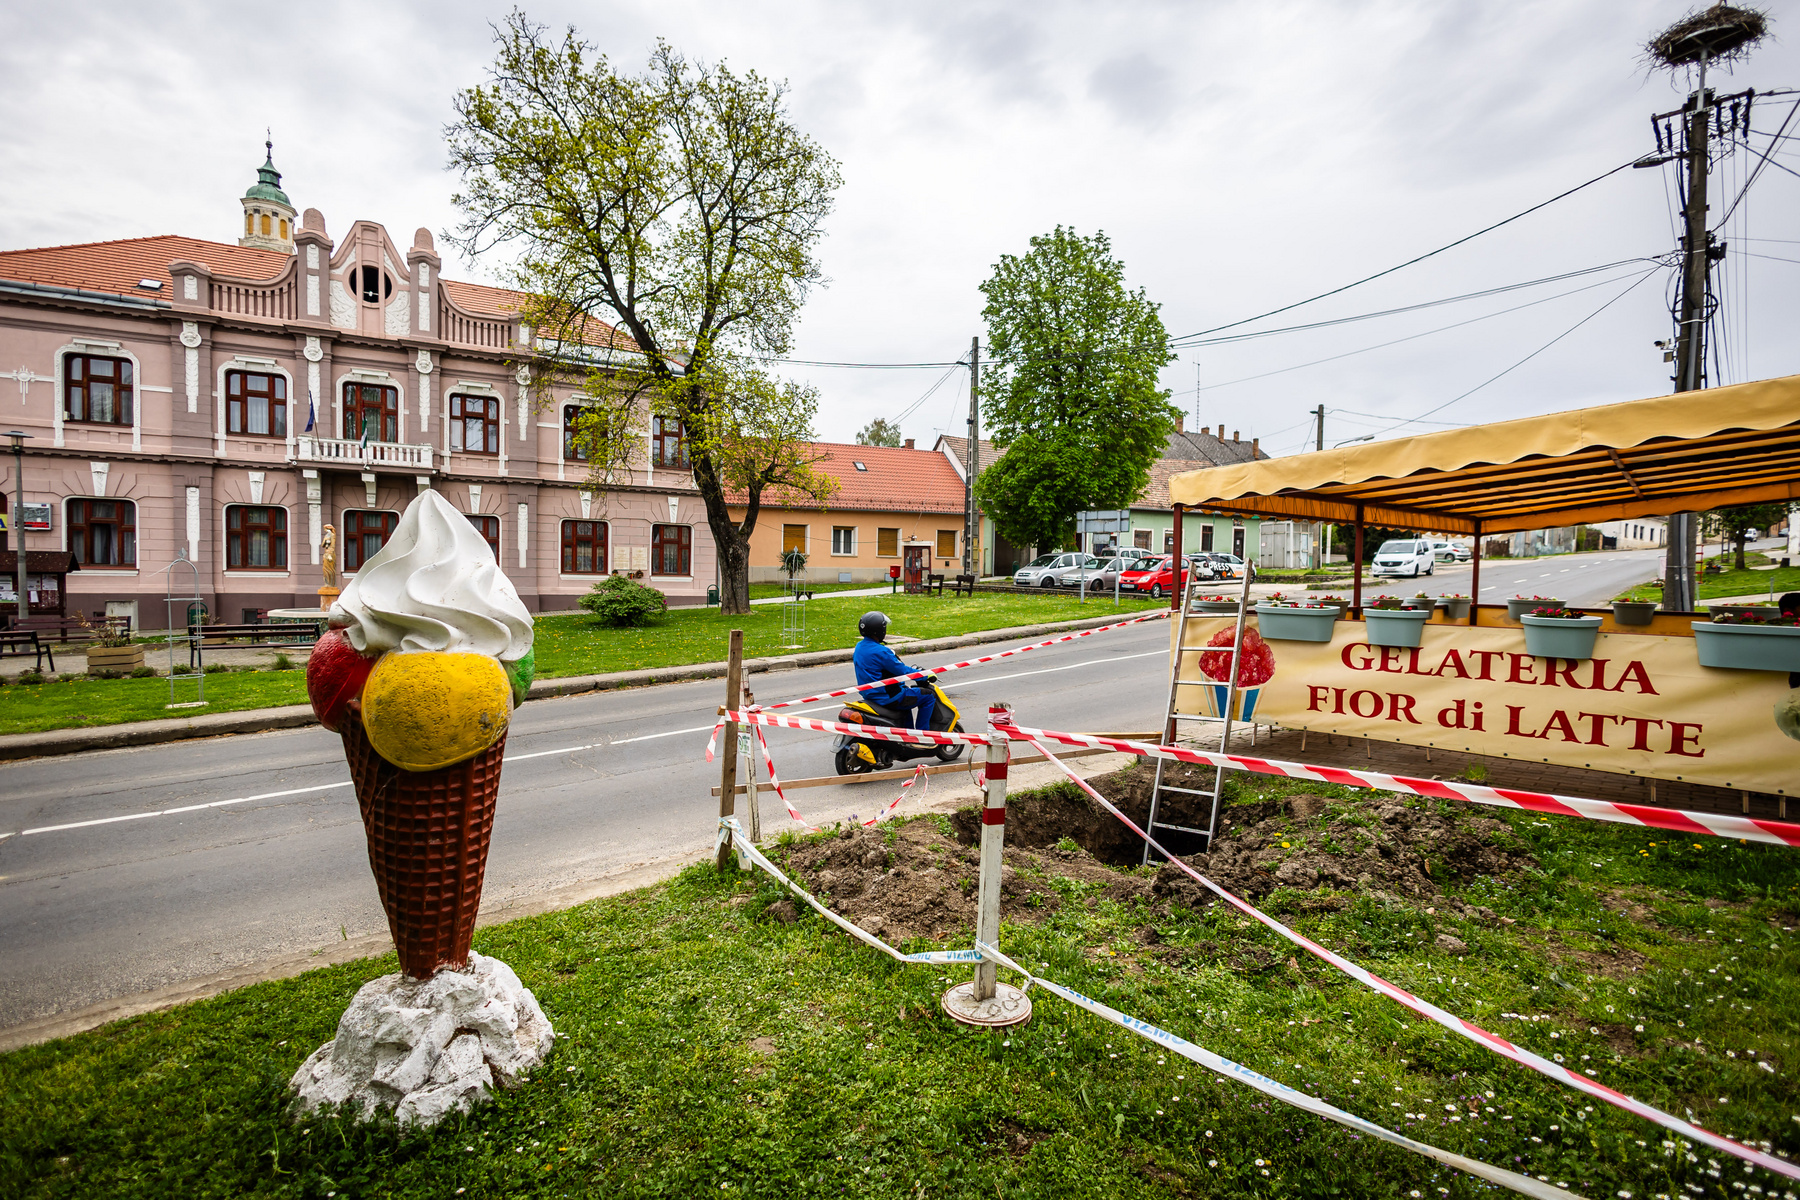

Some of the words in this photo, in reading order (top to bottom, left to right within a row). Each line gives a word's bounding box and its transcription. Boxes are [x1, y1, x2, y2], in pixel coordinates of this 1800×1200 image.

[1208, 560, 1230, 571] PRESS
[1341, 642, 1660, 696] GELATERIA
[1306, 684, 1422, 724] FIOR
[1437, 699, 1487, 732] di
[1504, 704, 1706, 758] LATTE
